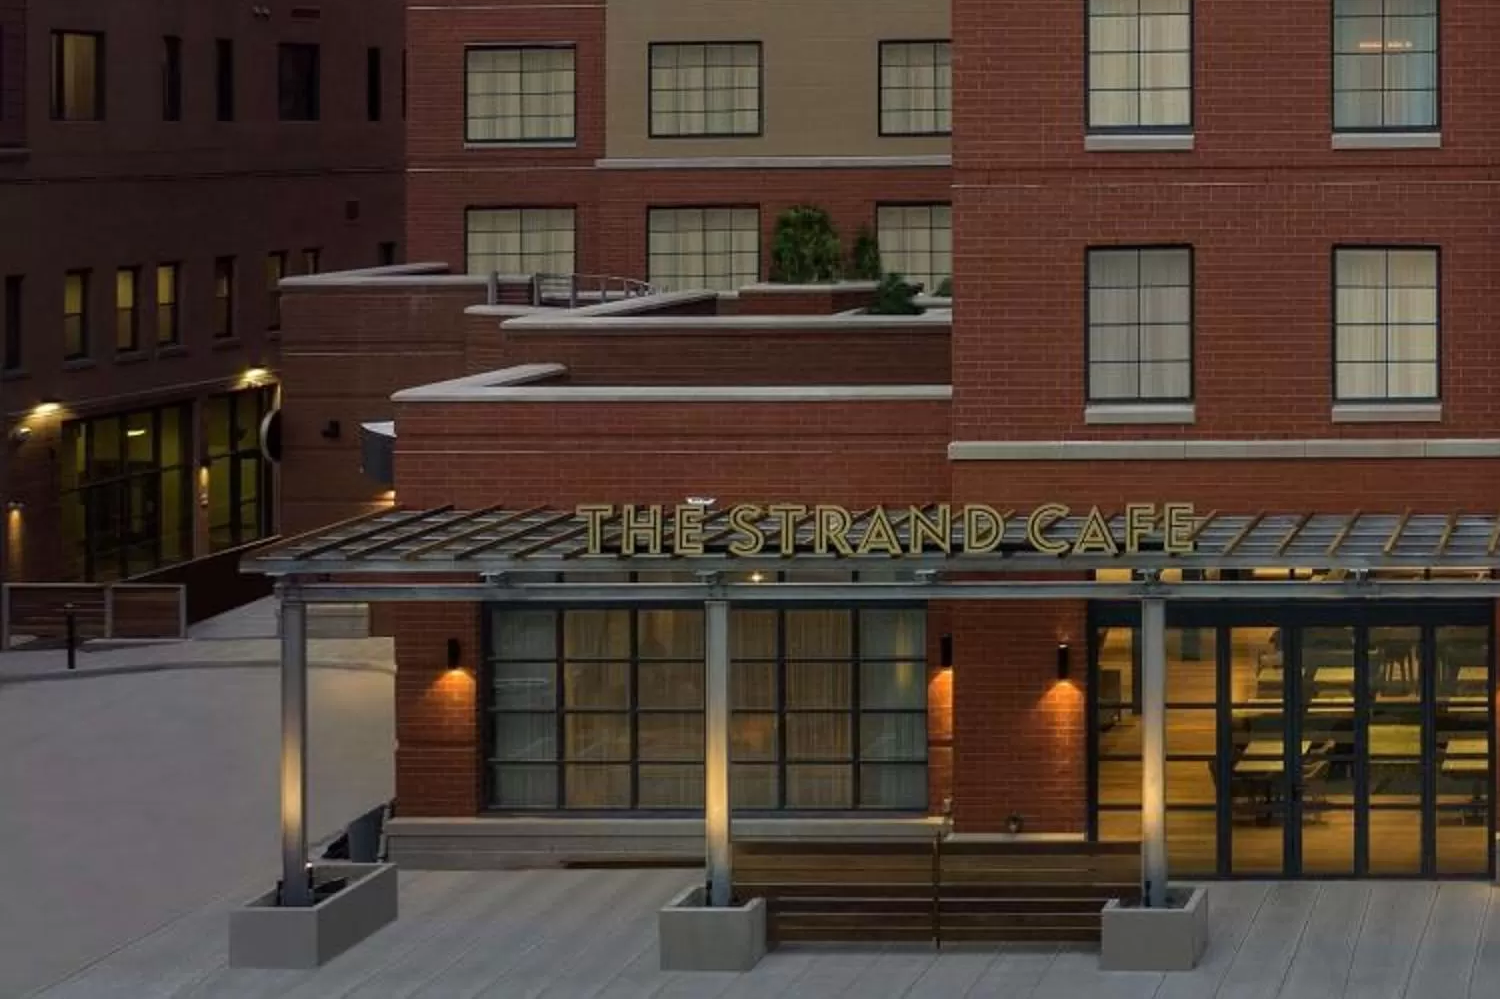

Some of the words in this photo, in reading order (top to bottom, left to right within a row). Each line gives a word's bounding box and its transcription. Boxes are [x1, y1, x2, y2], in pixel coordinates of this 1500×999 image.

[576, 503, 704, 555] THE
[728, 504, 1004, 555] STRAND
[1027, 503, 1195, 555] CAFE
